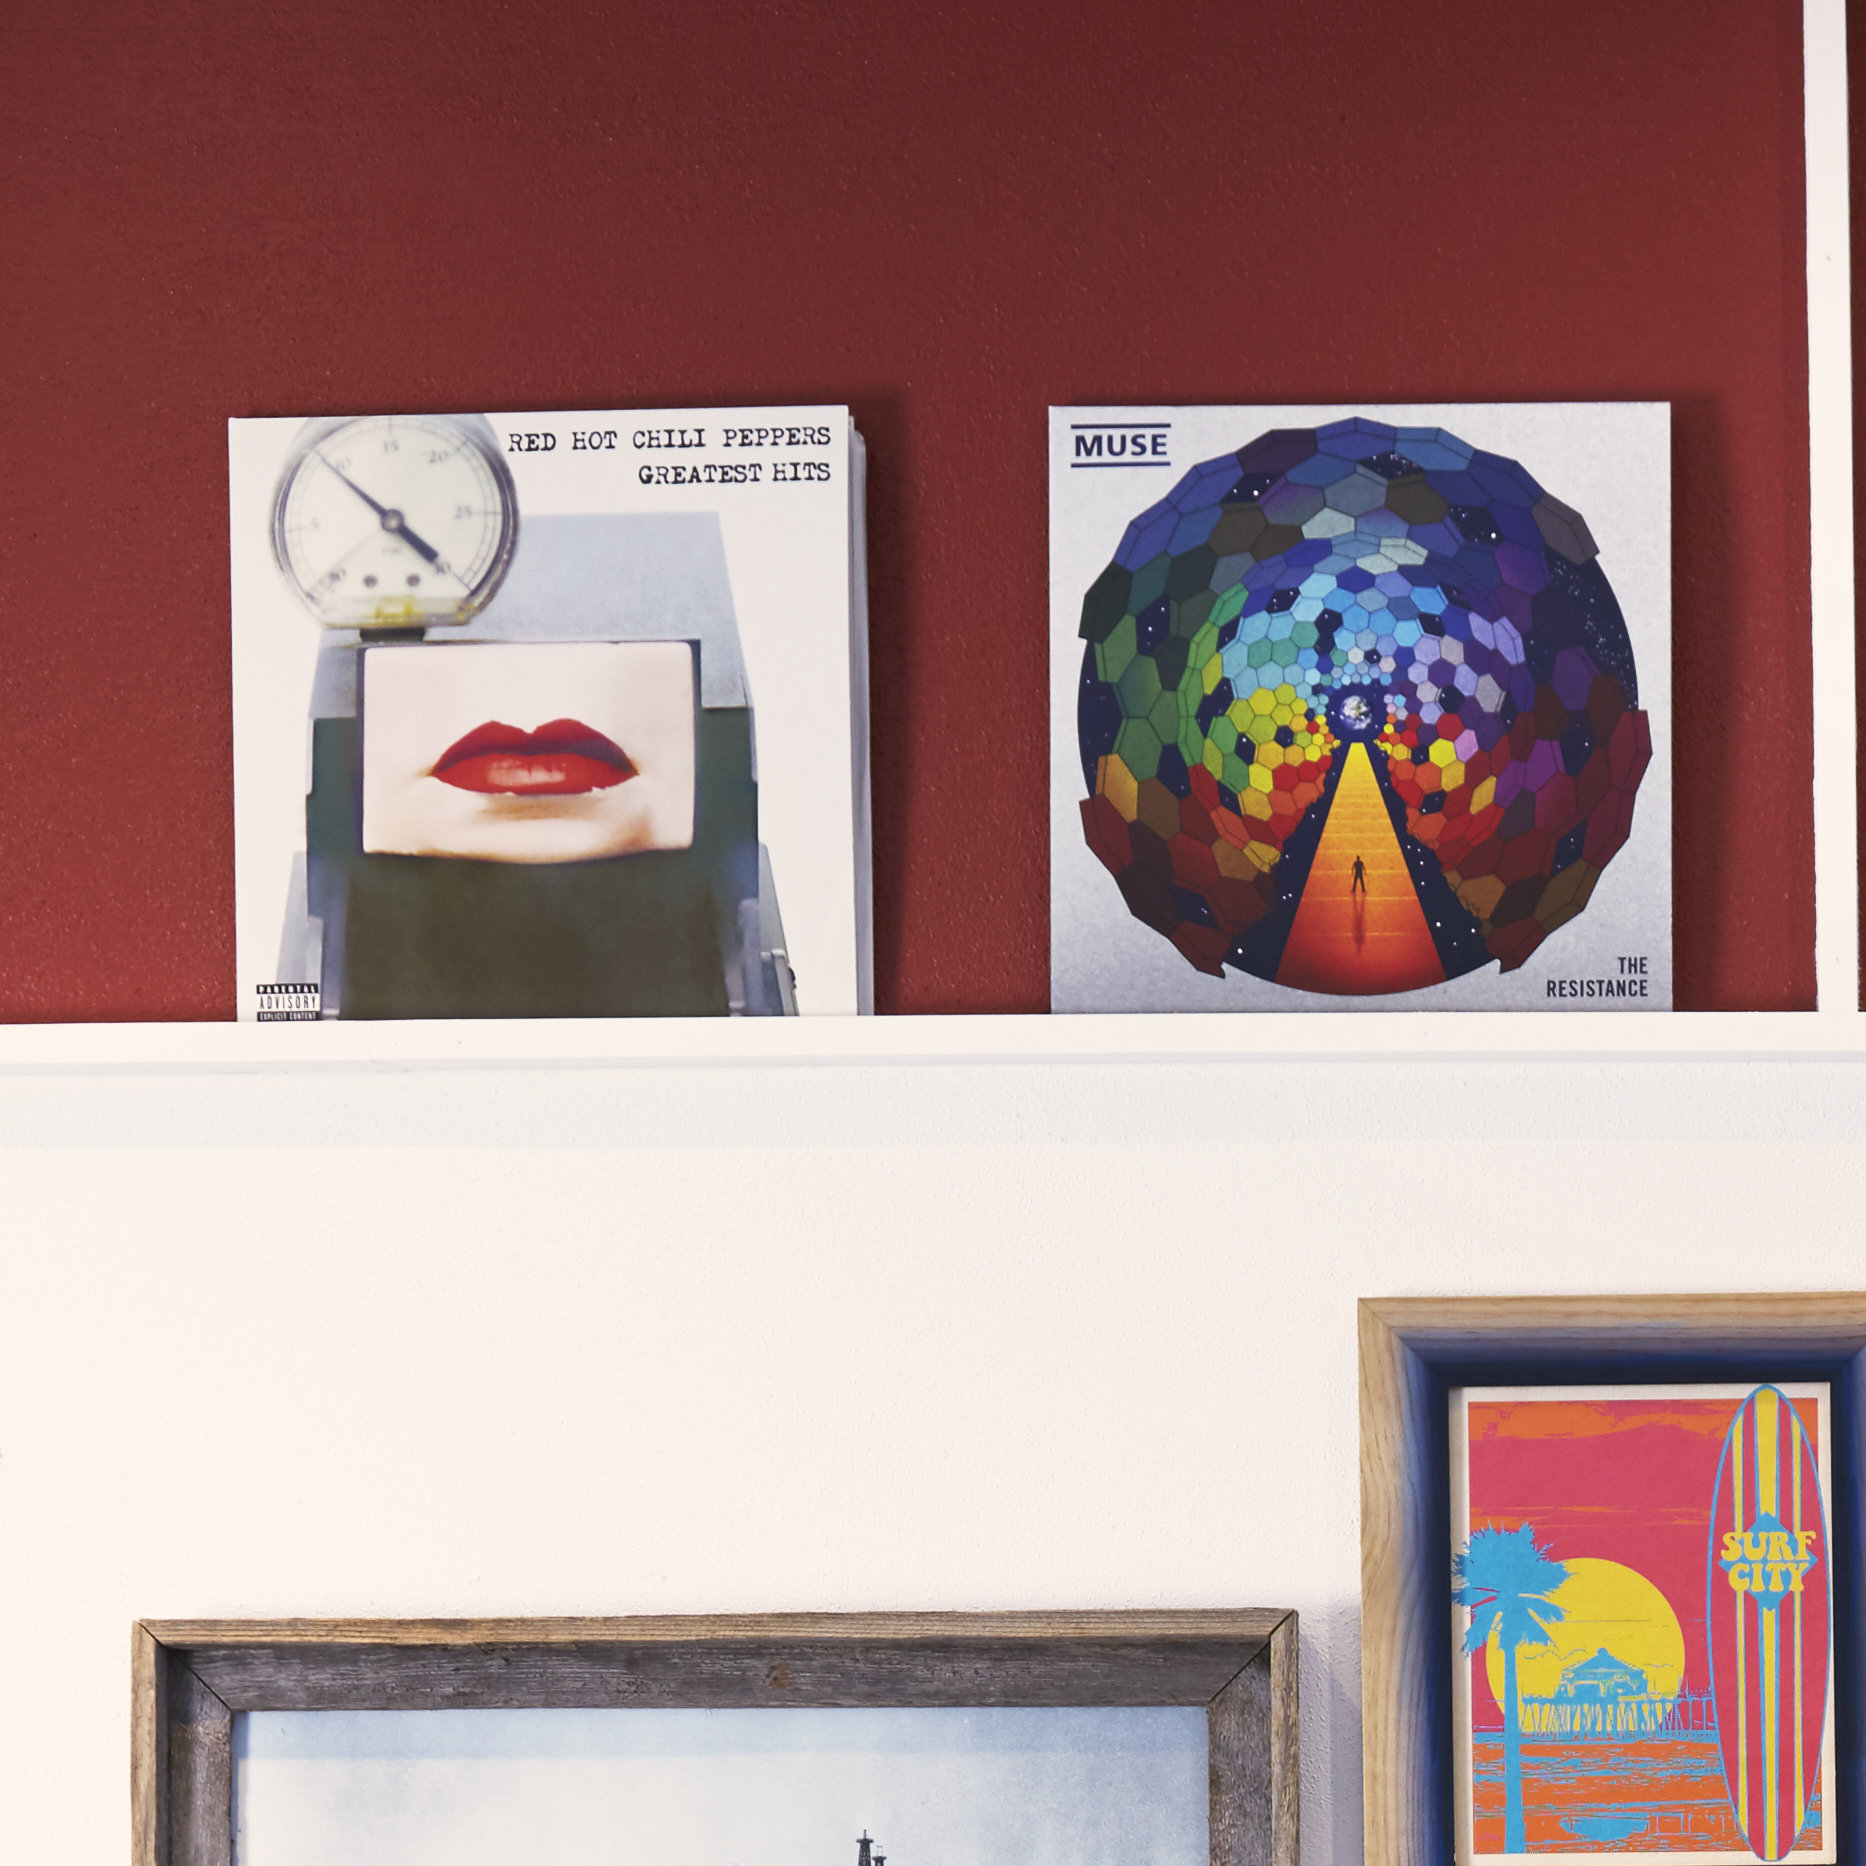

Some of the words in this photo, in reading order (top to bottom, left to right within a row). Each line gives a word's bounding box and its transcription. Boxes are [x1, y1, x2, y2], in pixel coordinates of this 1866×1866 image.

[508, 432, 557, 452] RED
[571, 431, 618, 450] HOT
[632, 428, 707, 449] CHILI
[722, 426, 832, 447] PEPPERS
[1075, 433, 1168, 457] MUSE
[638, 463, 763, 485] GREATEST
[771, 462, 832, 482] HITS
[1617, 956, 1649, 975] THE
[1546, 979, 1649, 998] RESISTANCE
[259, 995, 316, 1009] ADVISORY
[1720, 1530, 1817, 1561] SURF
[1728, 1562, 1810, 1592] CITY
